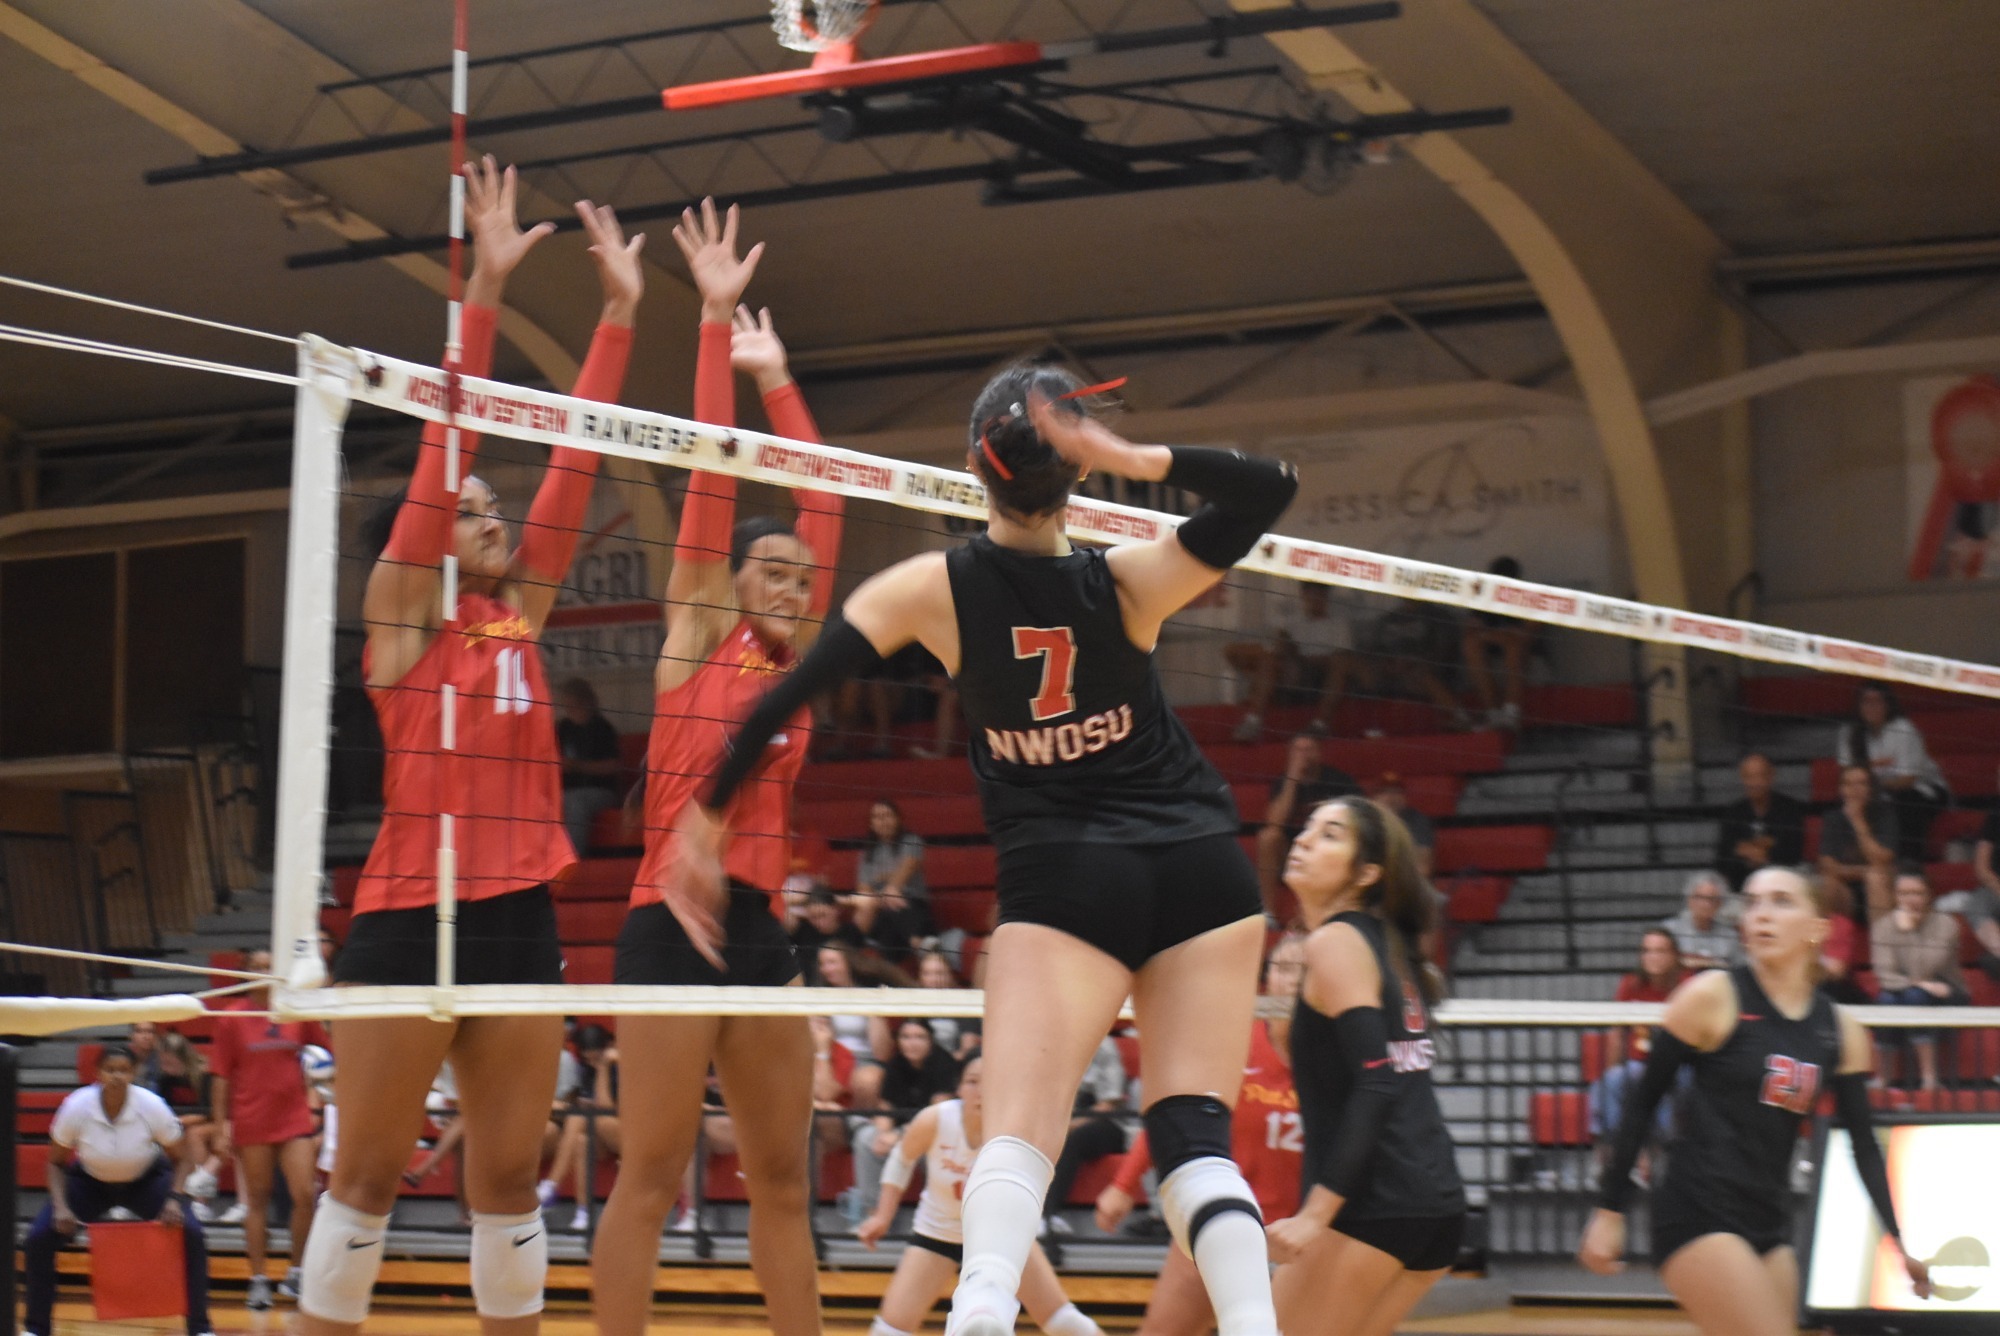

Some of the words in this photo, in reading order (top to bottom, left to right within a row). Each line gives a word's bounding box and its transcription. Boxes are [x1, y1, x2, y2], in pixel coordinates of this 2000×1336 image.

[583, 414, 697, 454] RANGERS
[755, 443, 894, 491] NORTHWESTERN
[1011, 626, 1078, 721] 7
[985, 703, 1133, 765] NWOSU
[1265, 1111, 1305, 1152] 12
